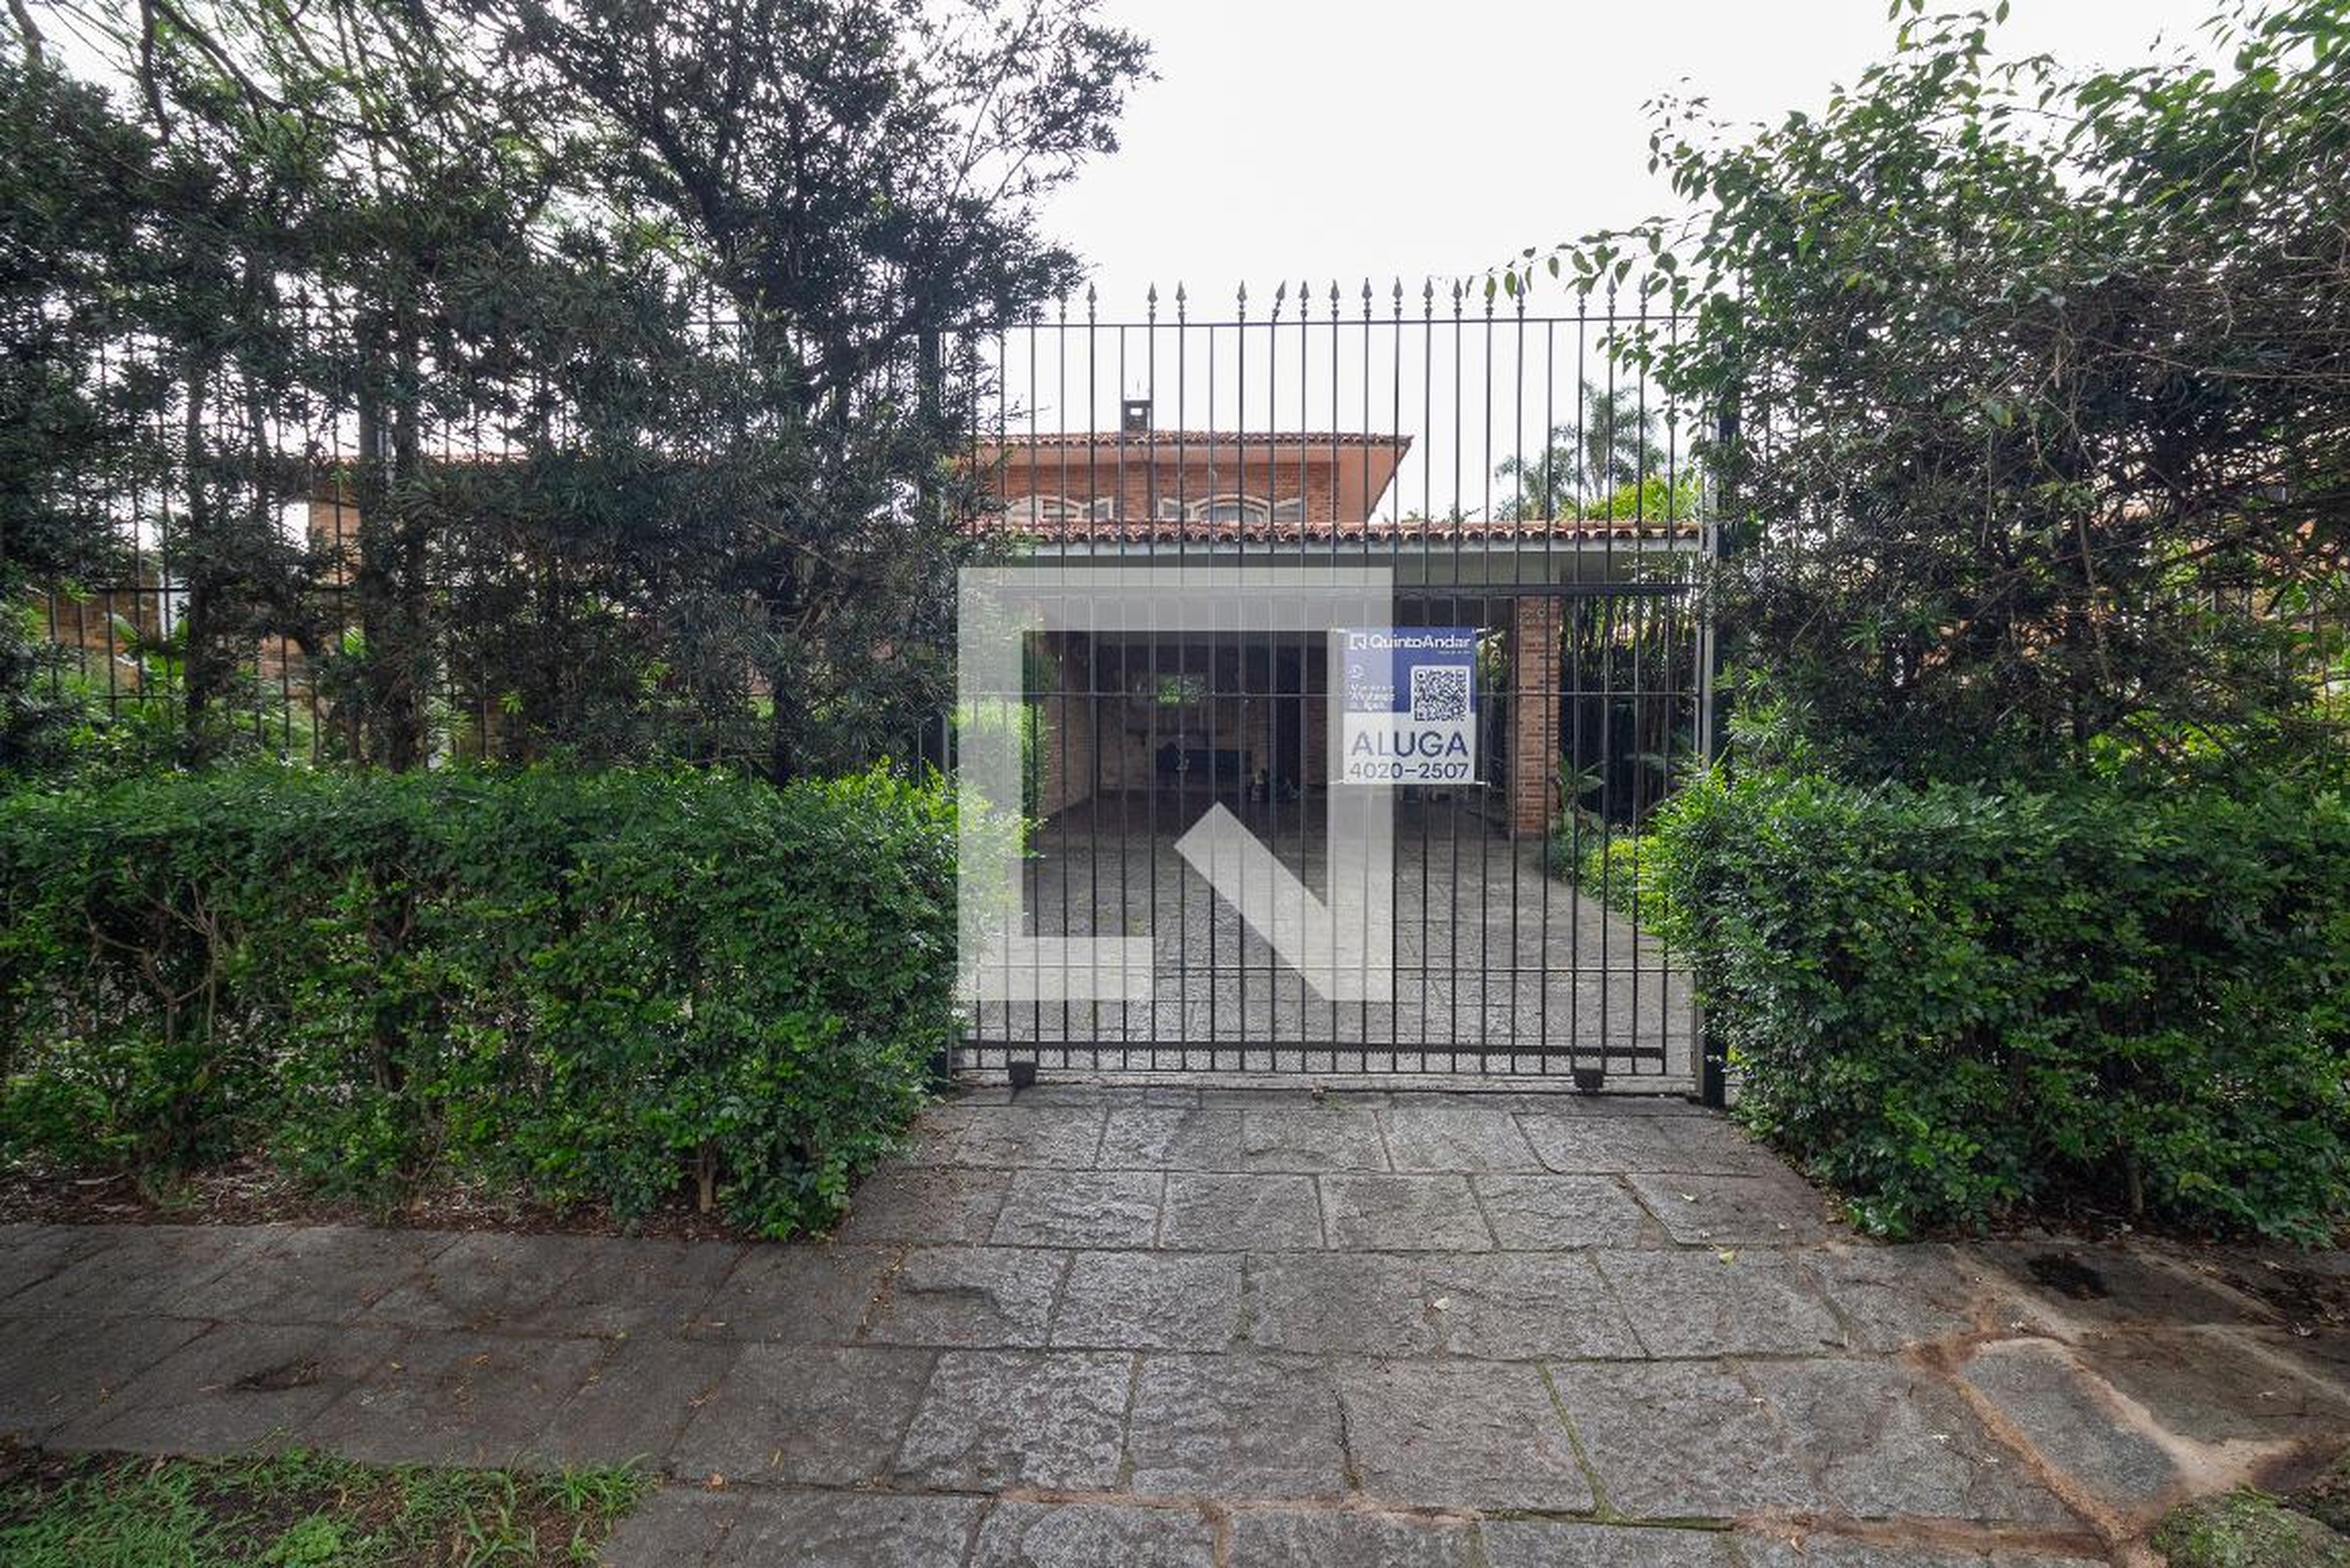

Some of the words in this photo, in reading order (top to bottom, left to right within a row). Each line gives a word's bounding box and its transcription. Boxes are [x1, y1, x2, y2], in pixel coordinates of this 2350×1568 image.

[1370, 634, 1470, 649] QuintoAndar
[1352, 731, 1468, 757] ALUGA
[1350, 763, 1468, 778] 4020-2507
